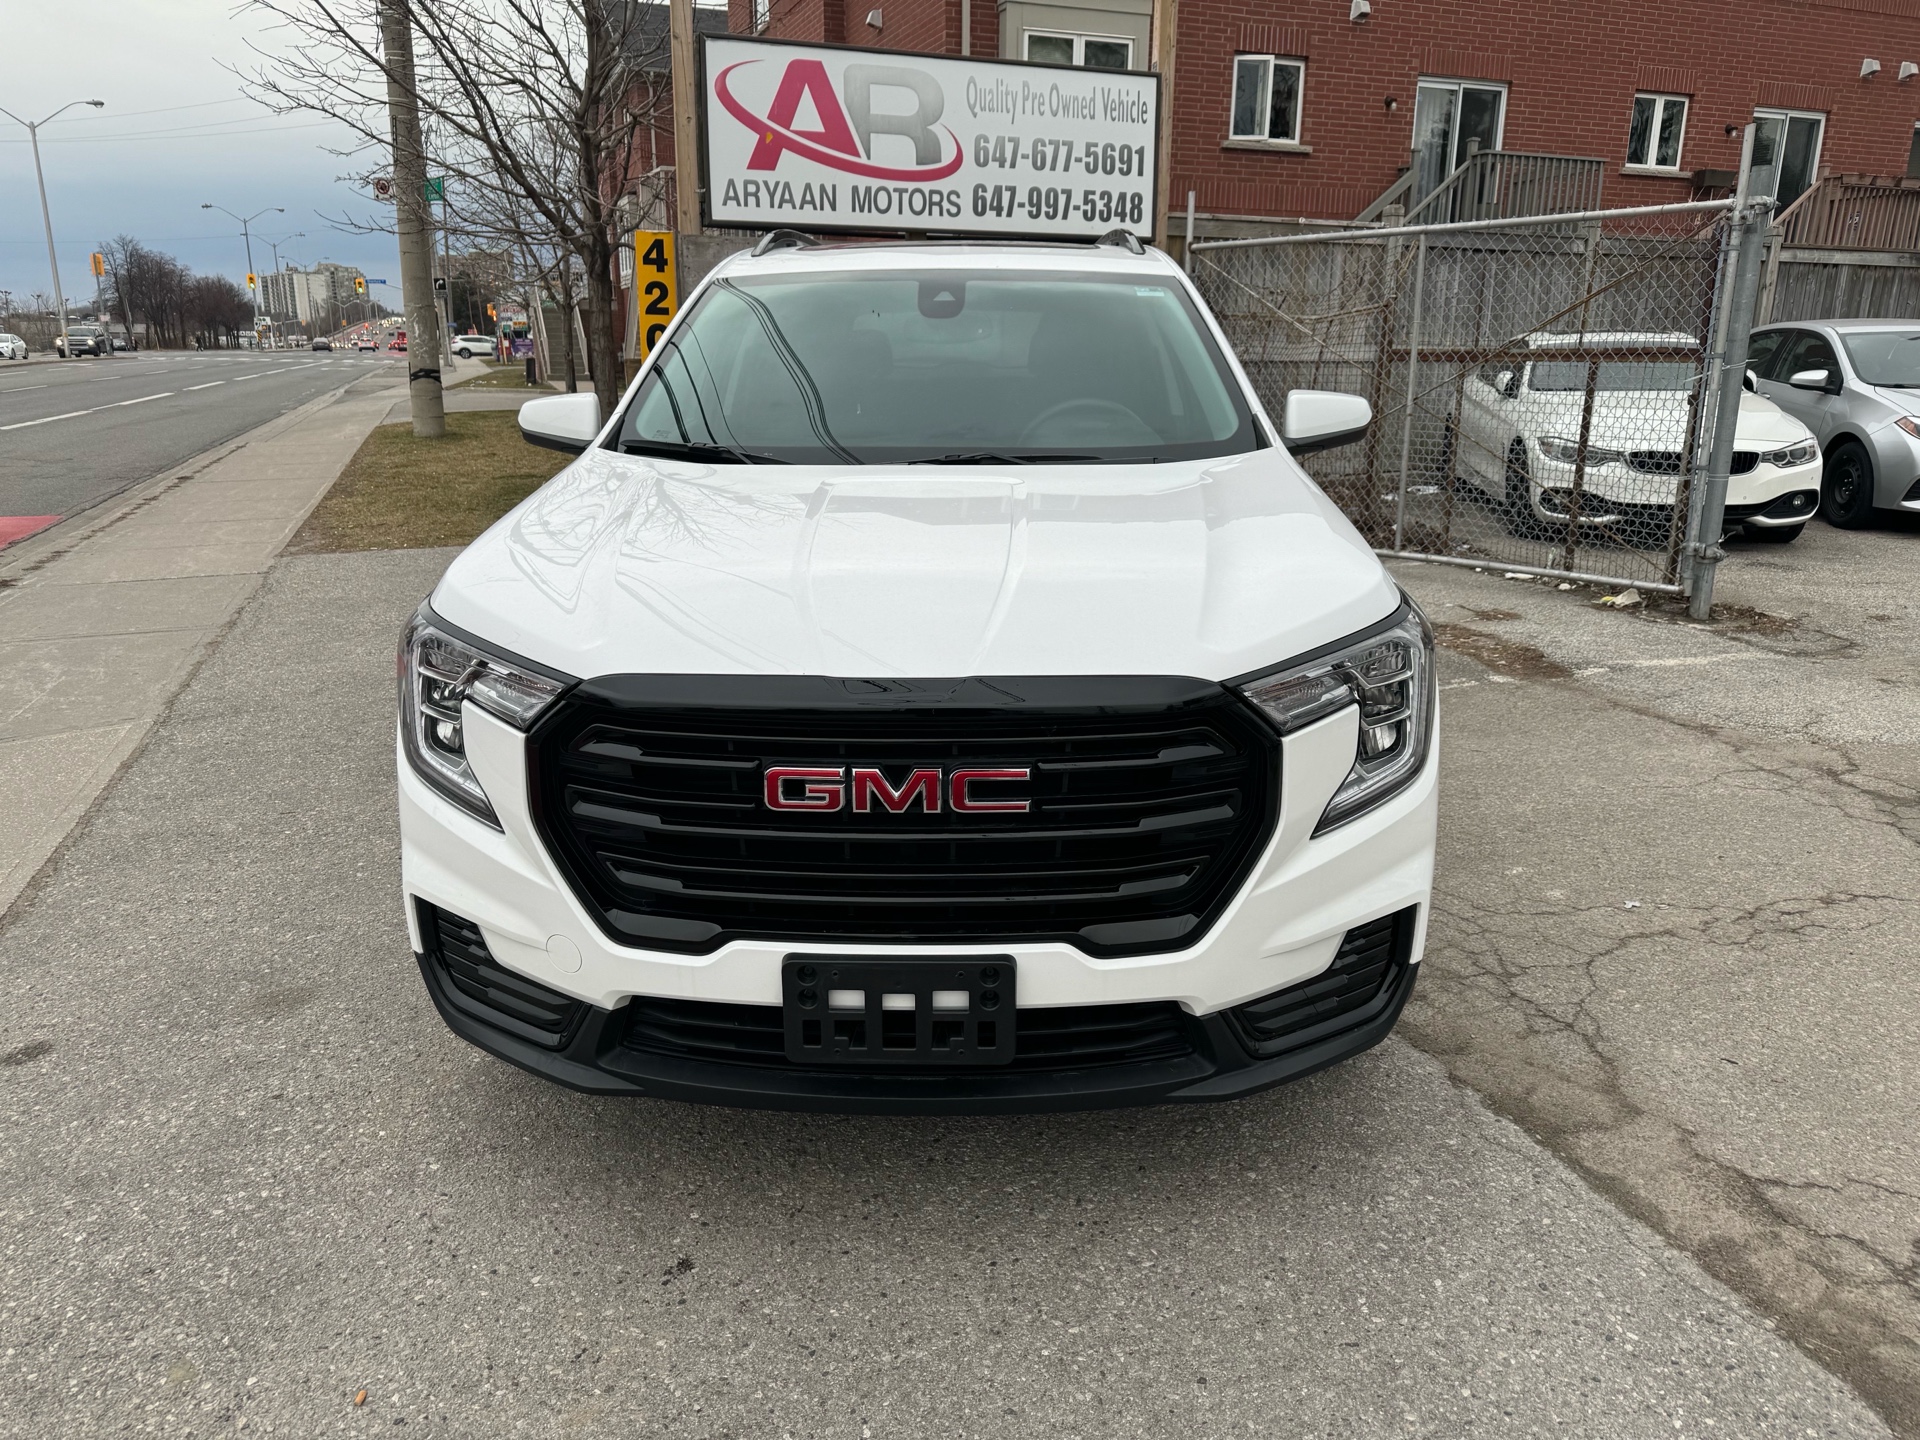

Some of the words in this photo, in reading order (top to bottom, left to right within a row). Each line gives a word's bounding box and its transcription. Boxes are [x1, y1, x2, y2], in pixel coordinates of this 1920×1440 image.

[746, 58, 945, 171] AR
[965, 75, 1018, 124] Quality
[1022, 81, 1045, 117] Pre
[1049, 83, 1096, 120] Owned
[1101, 87, 1148, 125] Vehicle
[973, 133, 1145, 177] 647-677-5691
[722, 178, 837, 212] ARYAAN
[851, 185, 962, 217] MOTORS
[972, 182, 1144, 224] 647-997-5348
[764, 766, 1031, 813] GMC
